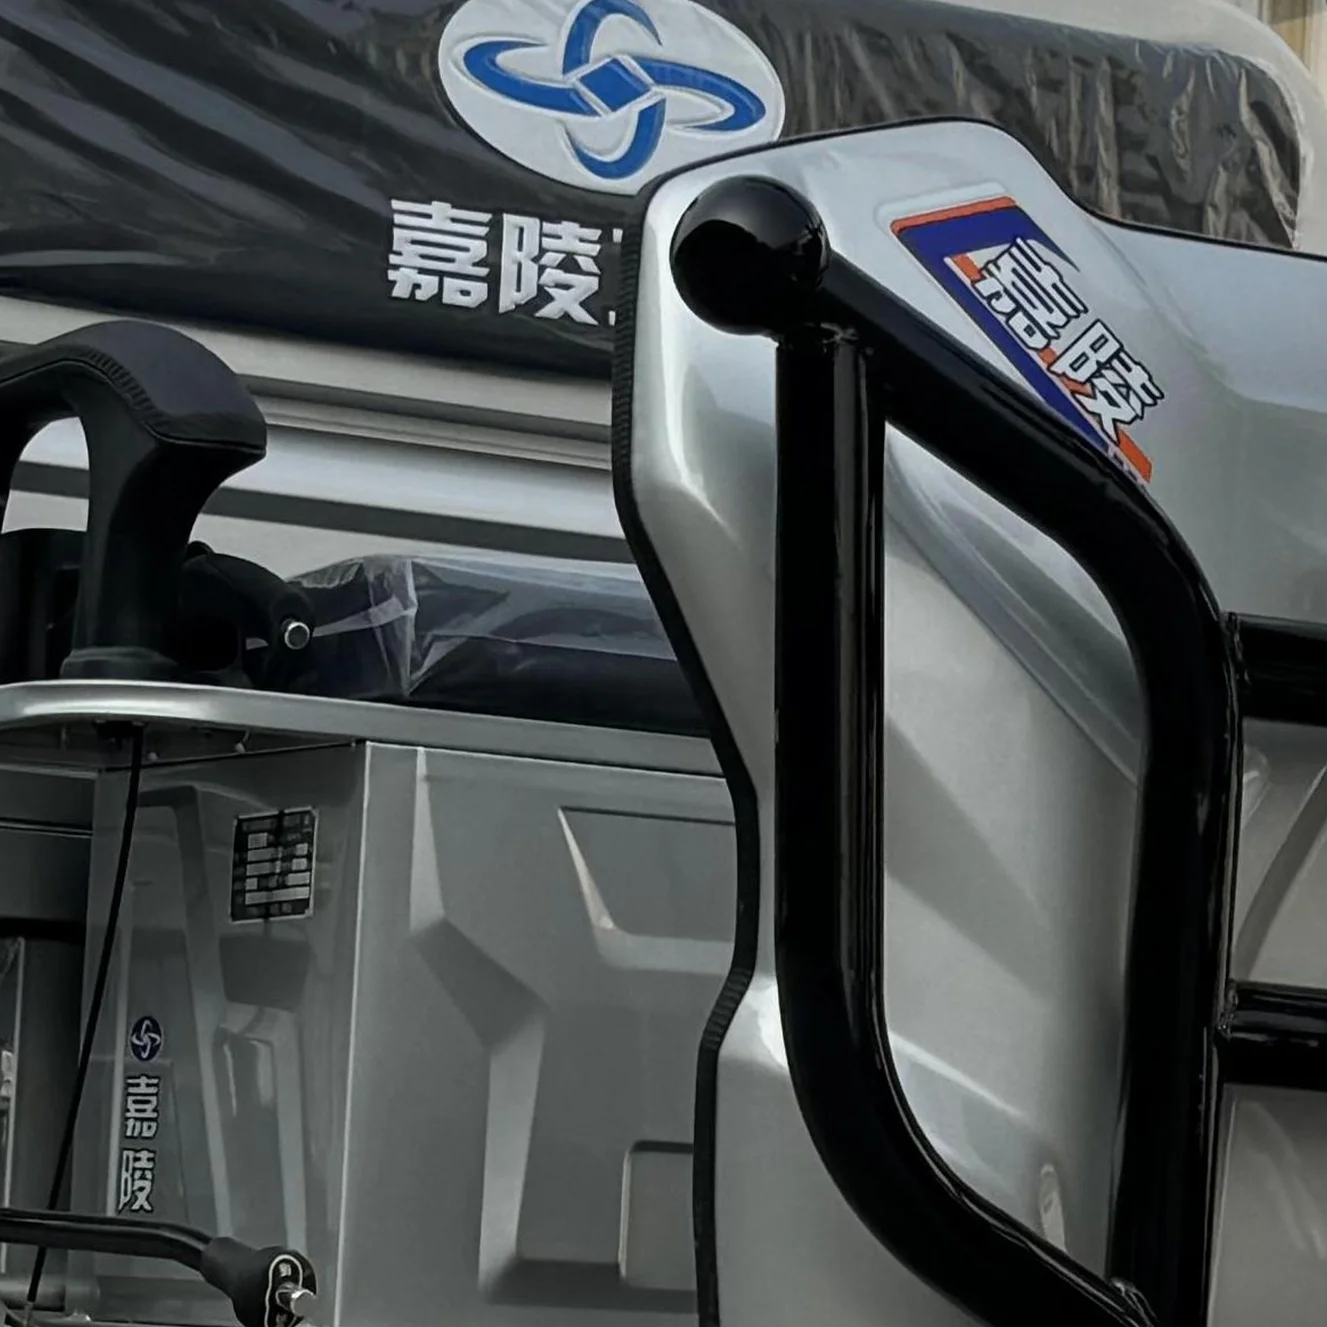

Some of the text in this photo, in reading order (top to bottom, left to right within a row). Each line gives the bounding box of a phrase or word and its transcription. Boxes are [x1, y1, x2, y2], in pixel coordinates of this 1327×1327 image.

[386, 198, 623, 328] 嘉陵
[972, 235, 1165, 446] 嘉陵
[118, 1074, 160, 1212] 嘉陵
